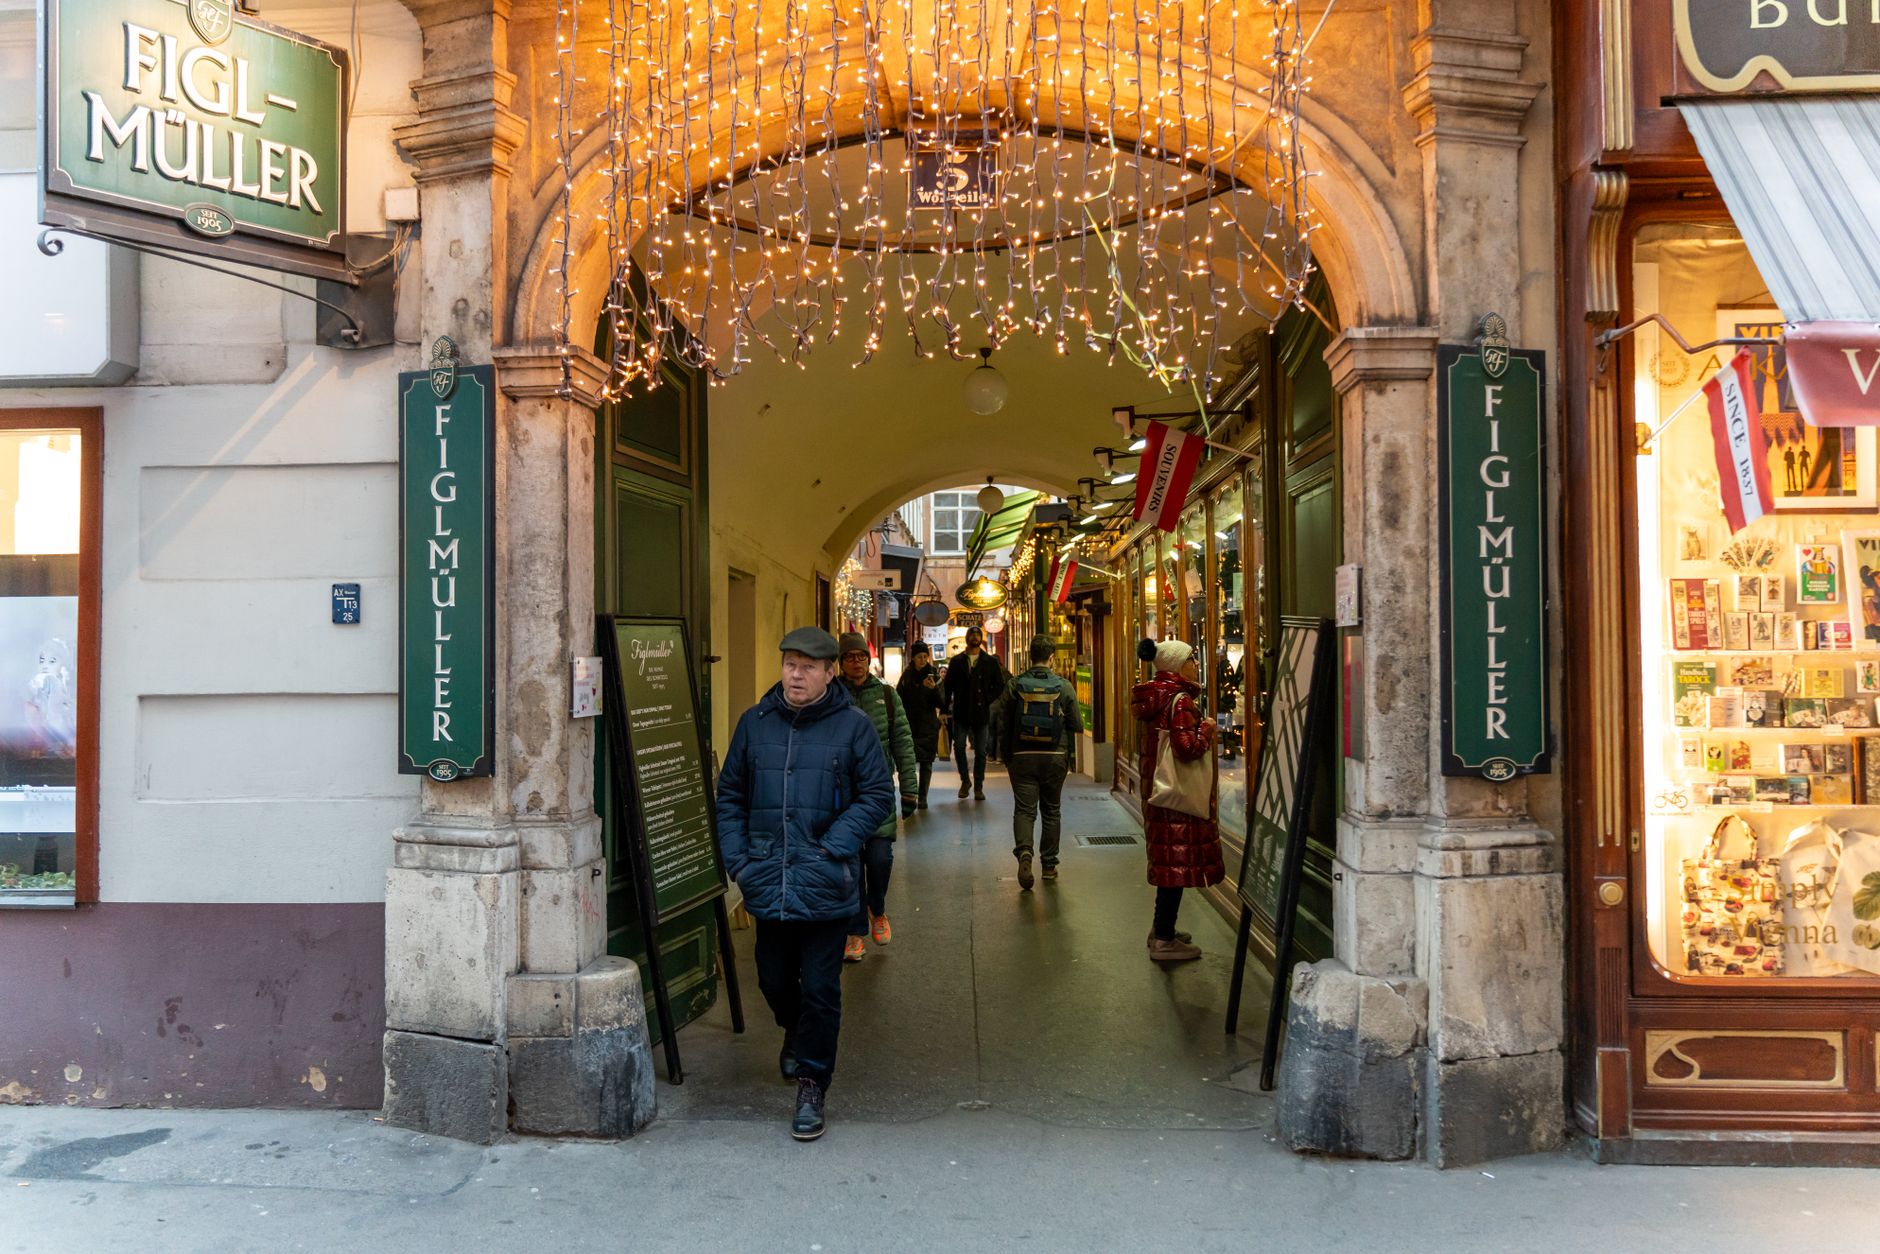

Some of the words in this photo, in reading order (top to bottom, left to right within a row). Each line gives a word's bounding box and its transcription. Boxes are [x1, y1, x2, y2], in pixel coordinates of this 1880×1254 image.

[82, 91, 322, 215] MÜLLER
[936, 153, 969, 192] 5
[200, 209, 218, 218] SEIT
[917, 191, 988, 204] Wolzeile
[197, 216, 222, 231] 1905
[1725, 383, 1746, 448] SINCE
[1740, 458, 1754, 495] 1837
[1148, 443, 1177, 513] SOUVENIRS
[428, 404, 460, 742] FIGLMÜLLER
[1477, 385, 1514, 740] FIGLMÜLLER
[343, 612, 354, 621] 25
[631, 639, 672, 676] Figlmüller
[1680, 668, 1708, 676] Handbuch
[1679, 675, 1711, 684] TAROCK
[436, 769, 452, 778] 1905
[1489, 768, 1508, 777] 1905
[1727, 873, 1840, 909] Simply
[1727, 911, 1839, 944] Vienna
